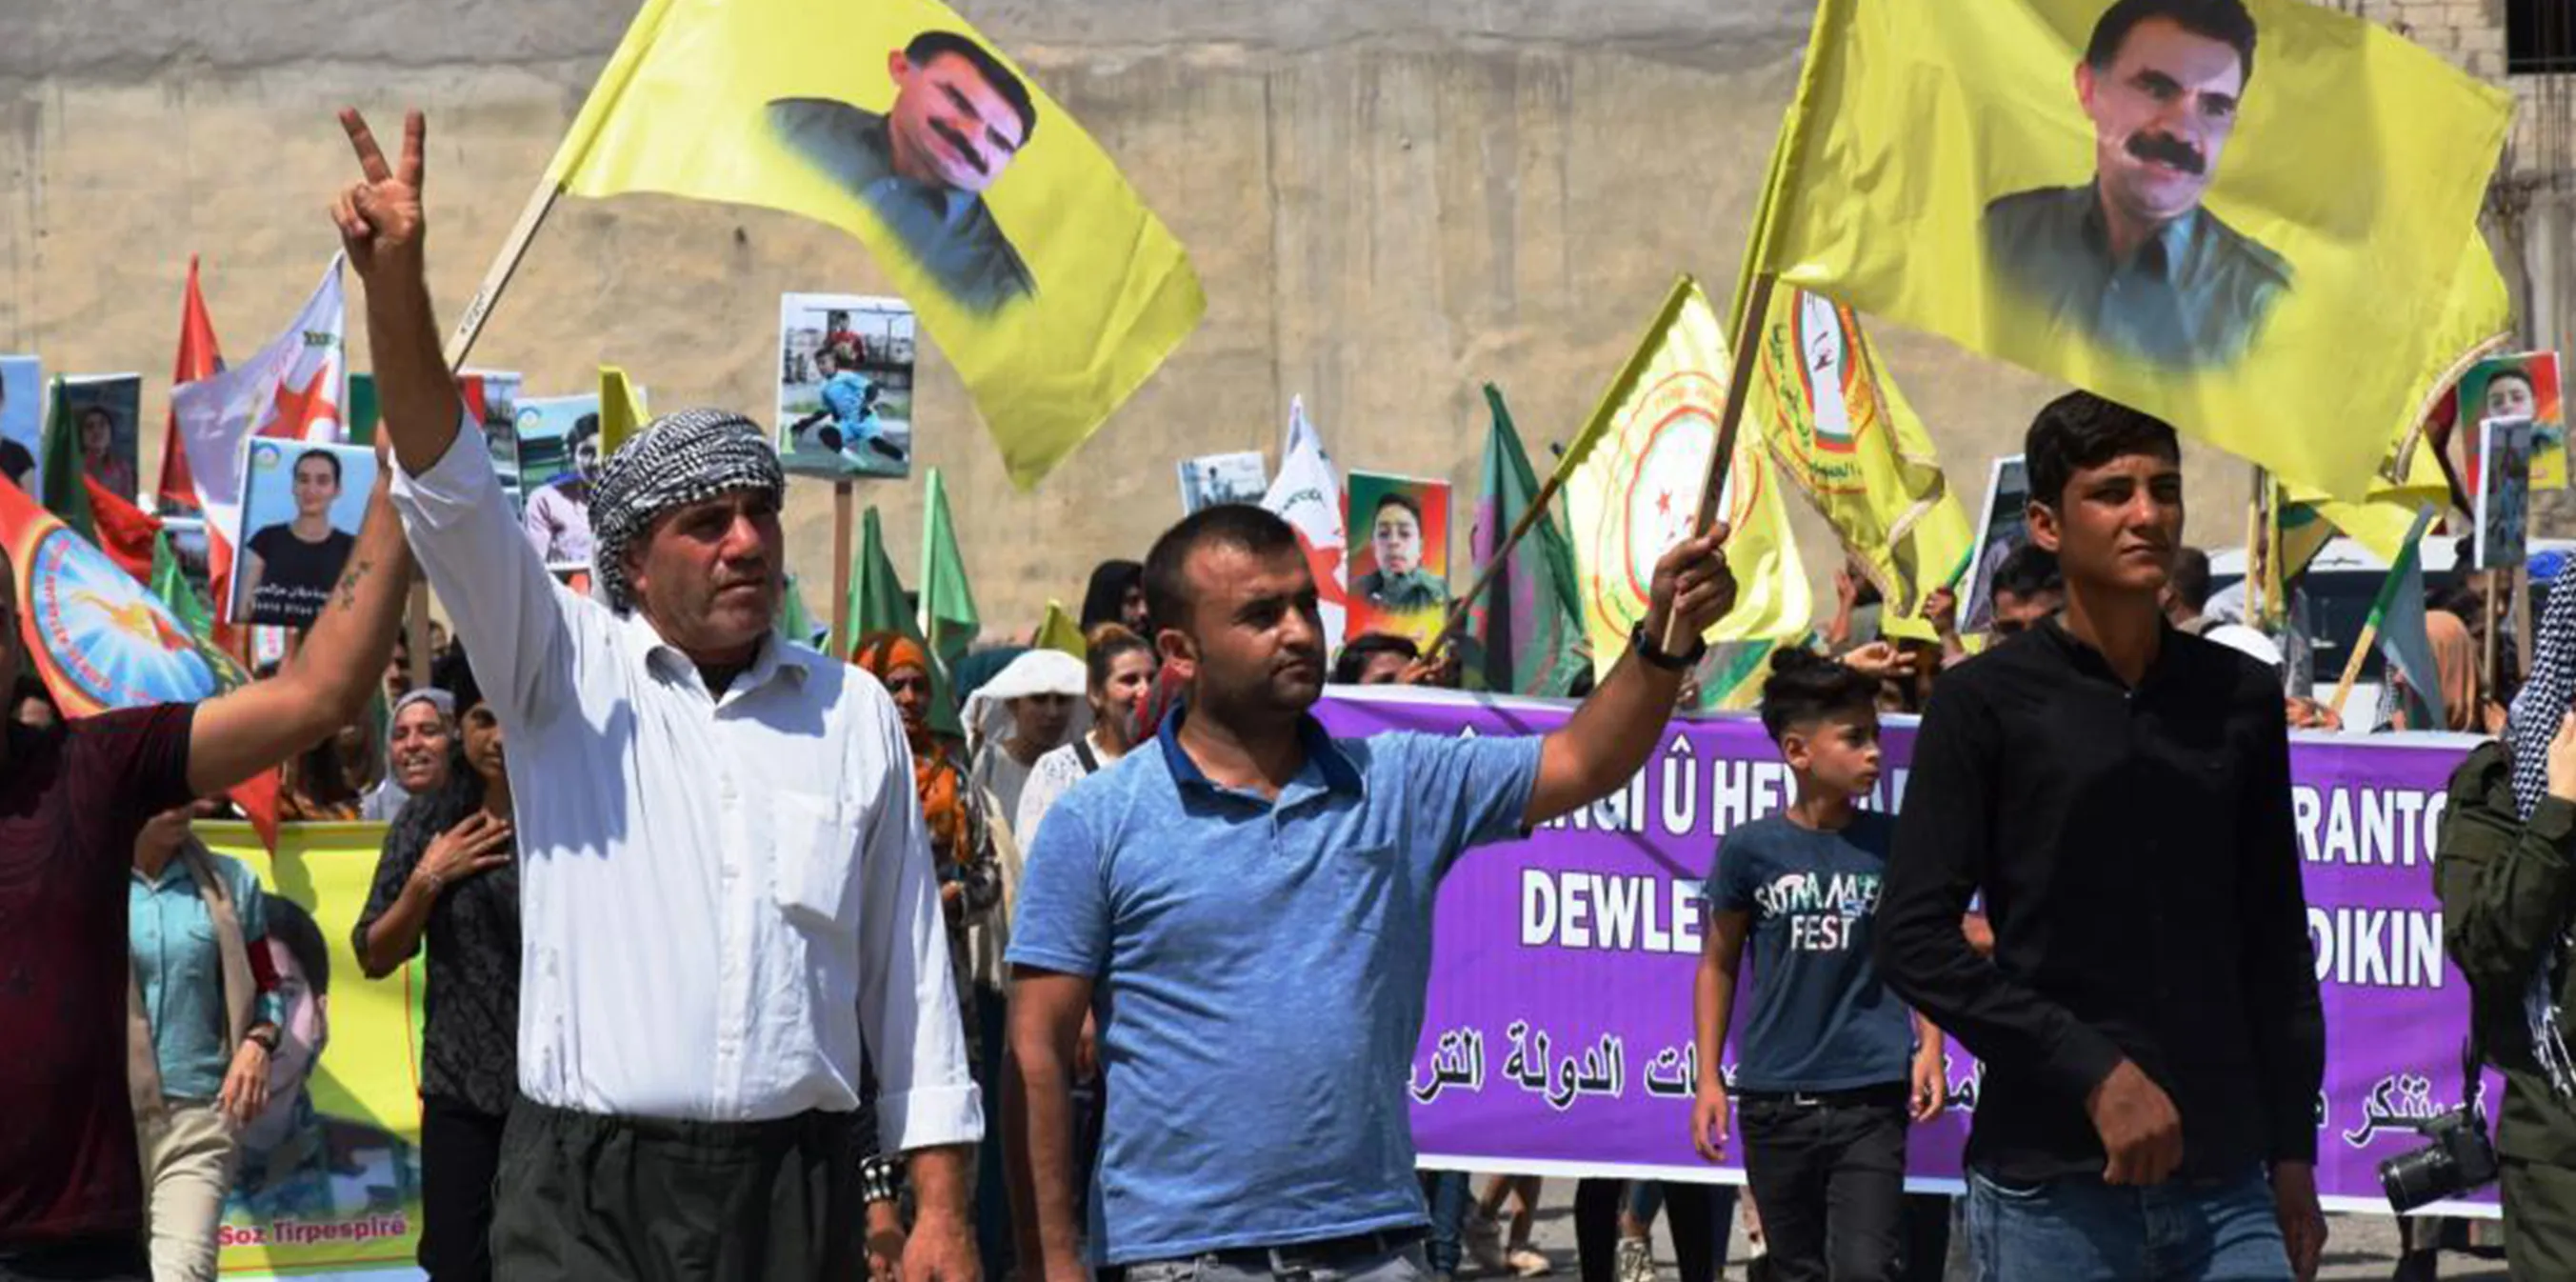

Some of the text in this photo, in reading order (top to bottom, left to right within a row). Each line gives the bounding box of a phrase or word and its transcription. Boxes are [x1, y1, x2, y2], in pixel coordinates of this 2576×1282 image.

[1662, 733, 1698, 835] Û
[1521, 868, 1706, 954] DEWLE
[1753, 871, 1886, 920] SUMME
[1789, 913, 1857, 951] FEST
[1409, 1025, 1484, 1105] التر
[1502, 1018, 1626, 1112] الدولة
